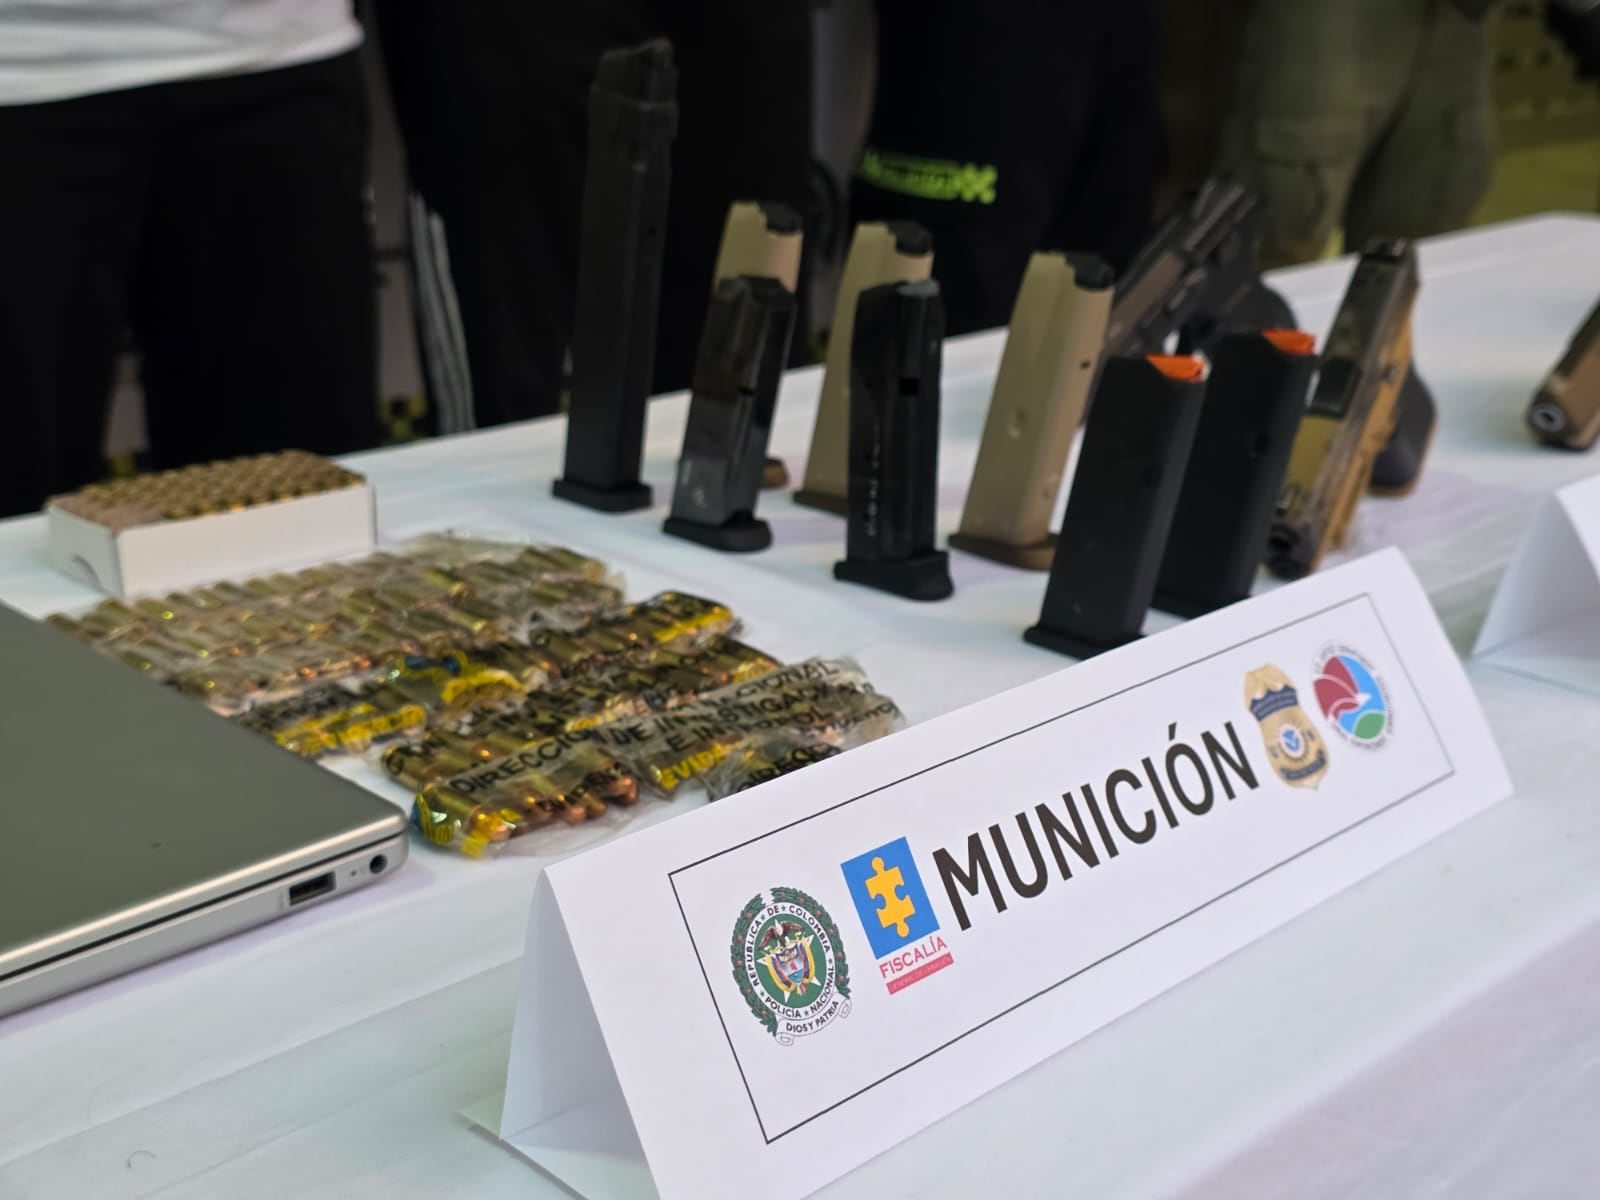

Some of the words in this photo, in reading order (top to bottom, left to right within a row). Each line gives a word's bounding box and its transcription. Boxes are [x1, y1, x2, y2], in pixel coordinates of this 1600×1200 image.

[609, 721, 654, 746] DE
[932, 721, 1260, 931] MUNICIÓN
[767, 904, 780, 917] DE
[789, 903, 831, 953] COLOMBIA
[879, 936, 948, 979] FISCALÍA
[810, 966, 834, 1013] NACIONAL
[815, 1001, 839, 1027] PATRIA
